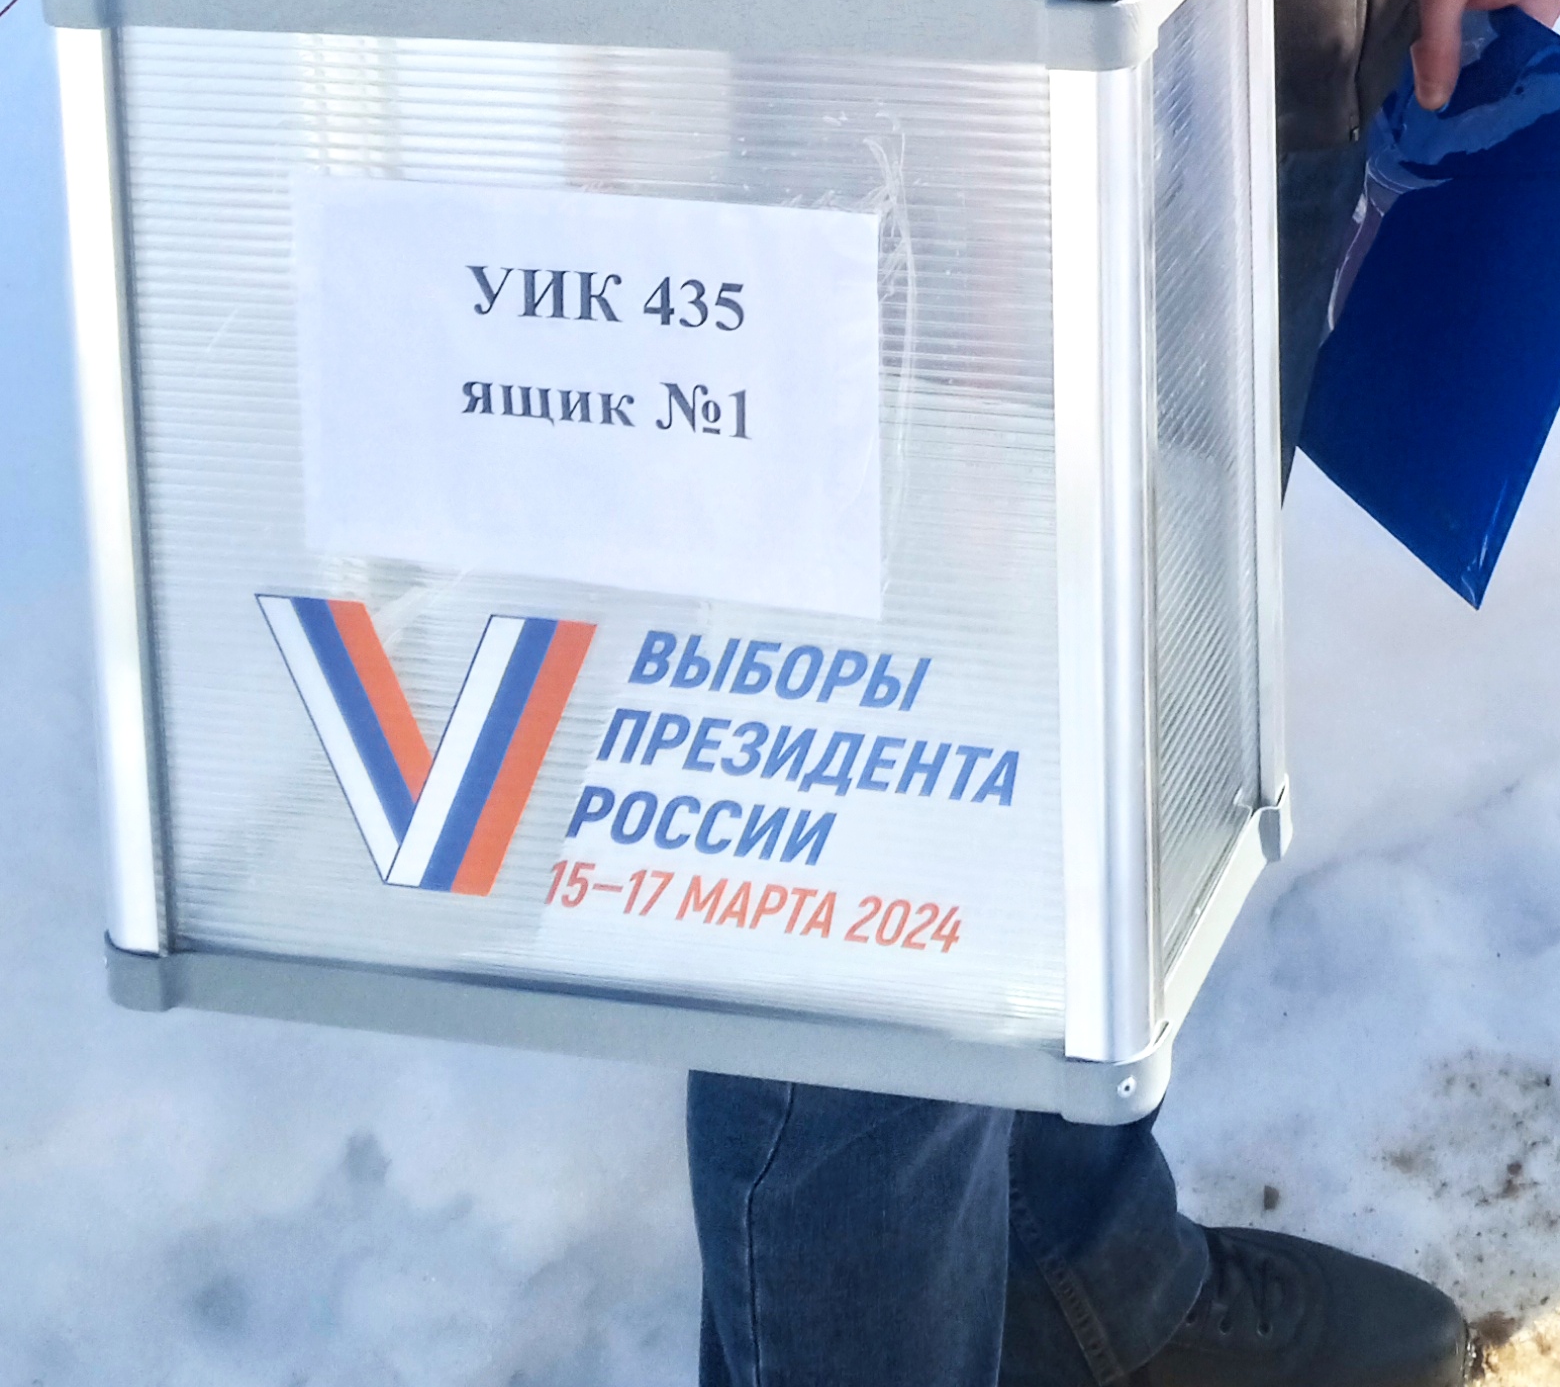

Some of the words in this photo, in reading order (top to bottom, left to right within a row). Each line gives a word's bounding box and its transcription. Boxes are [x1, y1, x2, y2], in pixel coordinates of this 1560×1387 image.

[465, 265, 623, 322] УИК
[643, 277, 744, 331] 435
[461, 381, 636, 427] ящик
[655, 382, 752, 440] №1
[627, 629, 931, 713] ВЫБОРЫ
[596, 709, 1020, 807] ПРЕЗИДЕНТА
[566, 785, 838, 866] РОССИИ
[676, 875, 837, 939] МАРТА
[844, 895, 963, 954] 2024
